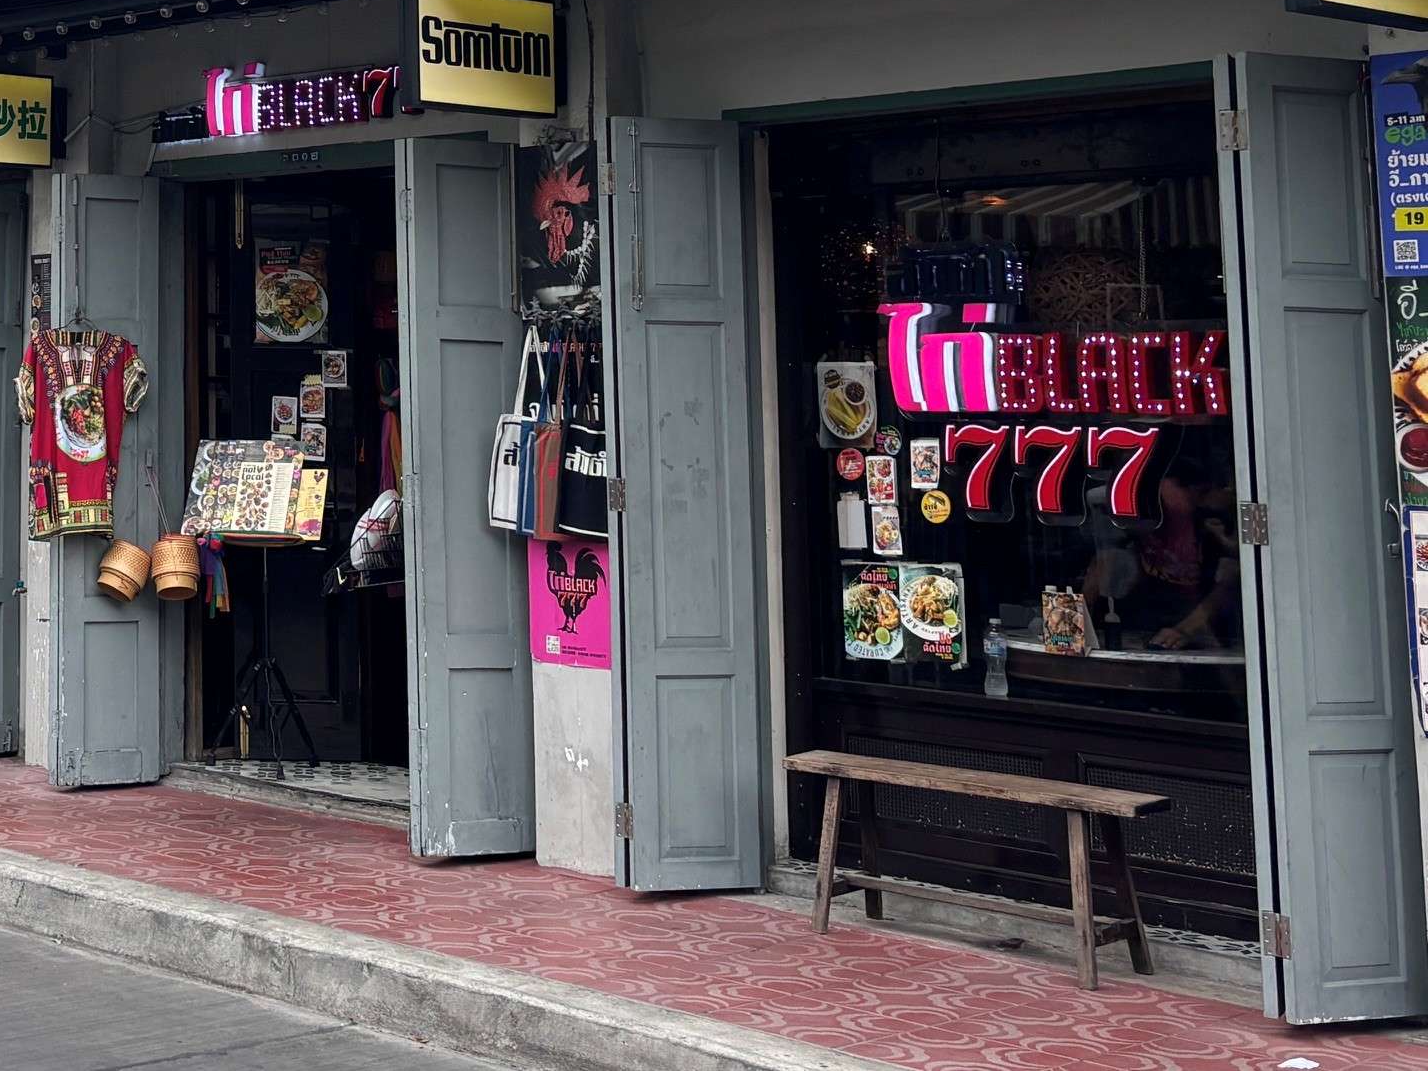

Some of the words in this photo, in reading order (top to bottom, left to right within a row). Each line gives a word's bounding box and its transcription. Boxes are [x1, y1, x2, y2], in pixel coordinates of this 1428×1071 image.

[996, 330, 1229, 416] BLACK
[944, 424, 1160, 518] 777
[565, 577, 595, 594] BLACK
